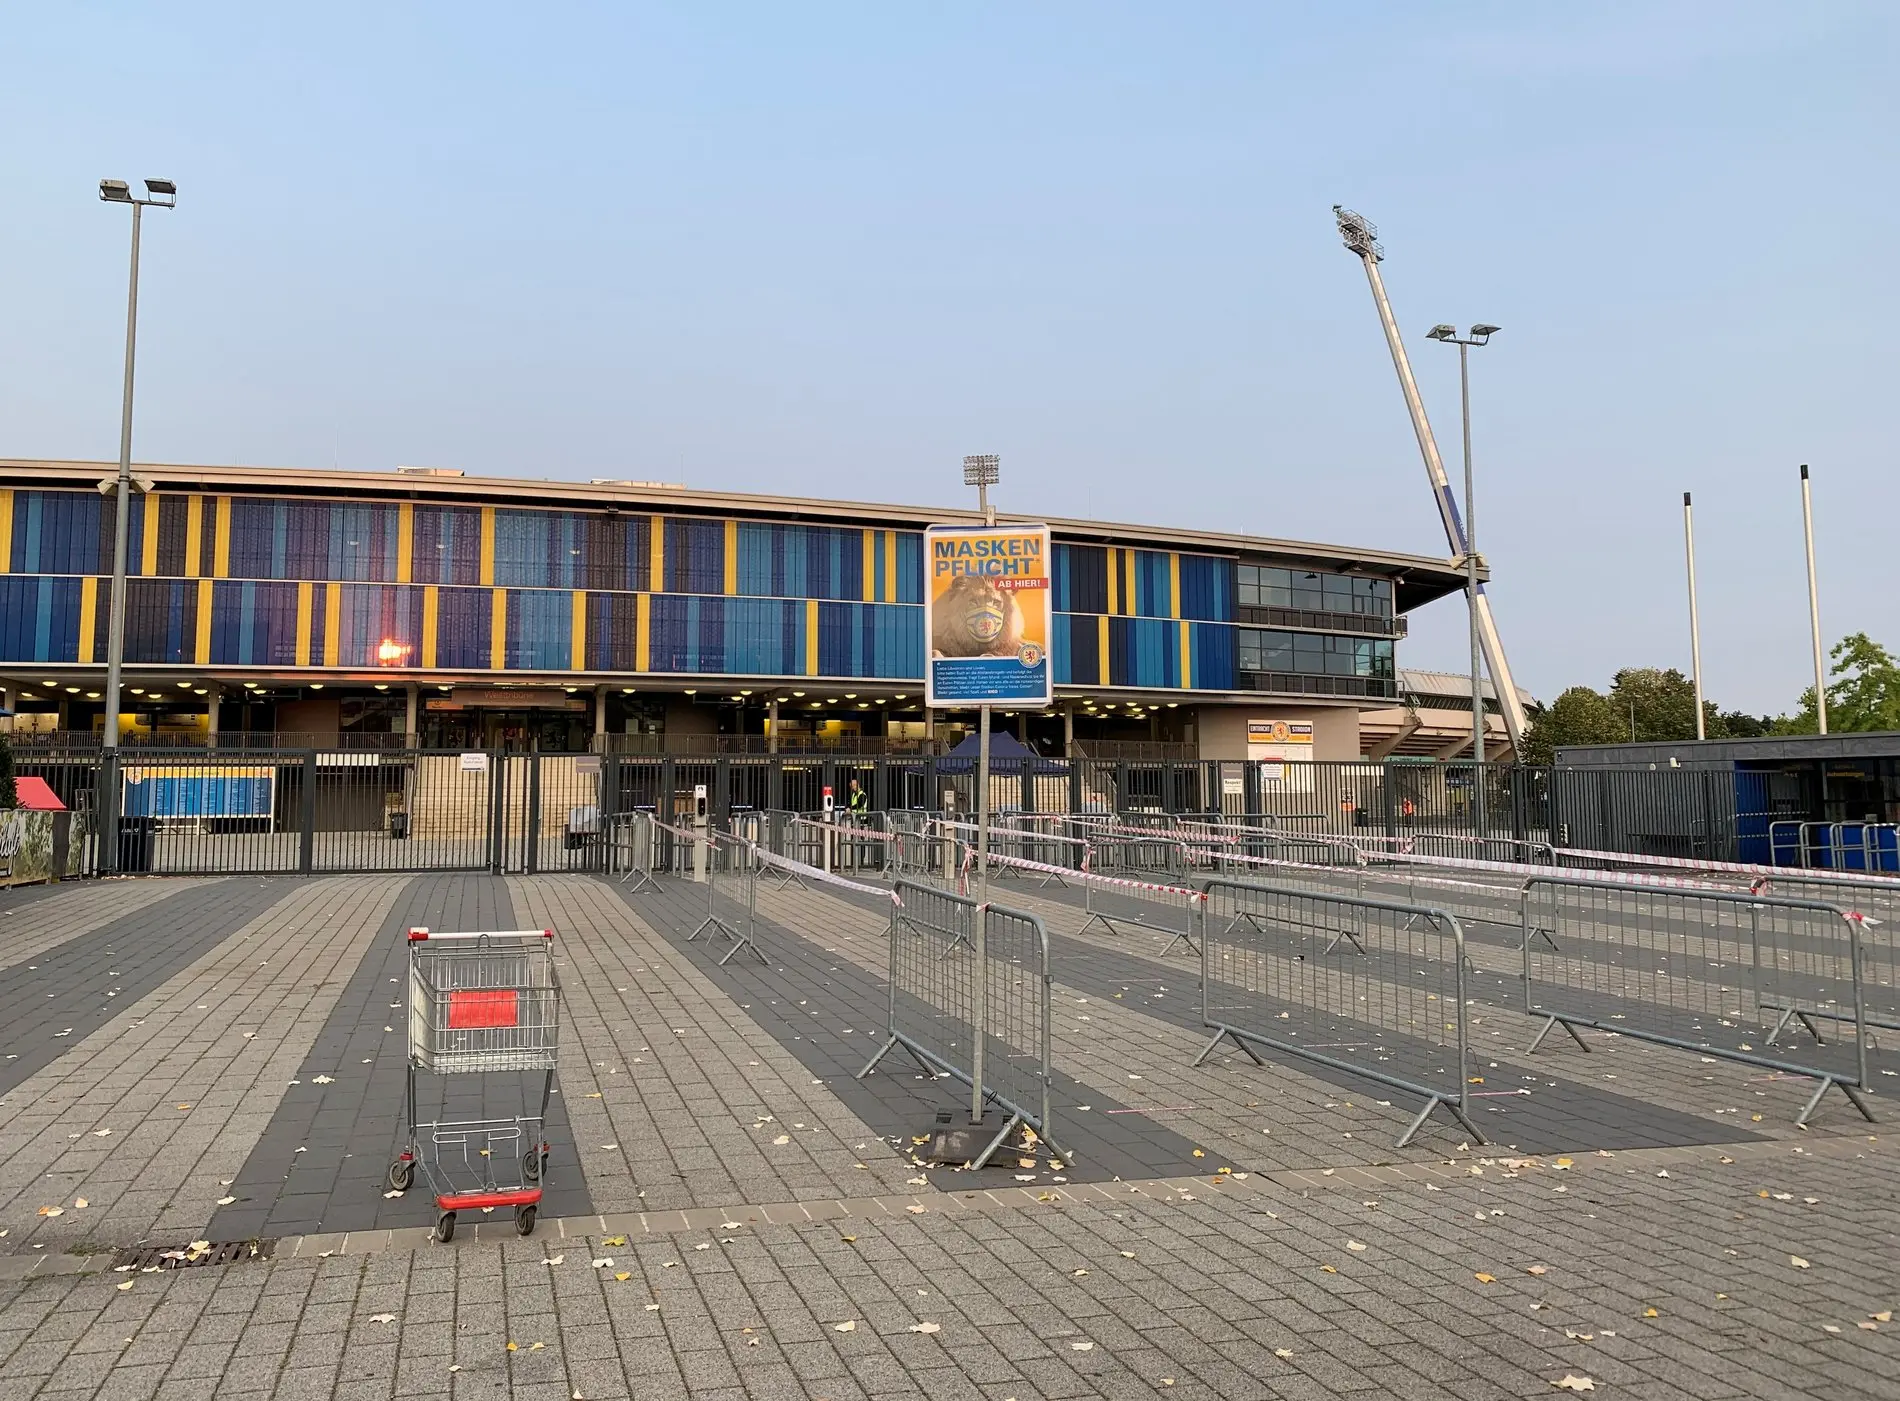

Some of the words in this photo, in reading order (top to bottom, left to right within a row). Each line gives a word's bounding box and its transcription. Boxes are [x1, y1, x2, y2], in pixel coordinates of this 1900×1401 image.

[935, 538, 1040, 558] MASKEN
[997, 580, 1012, 588] AB
[1014, 579, 1041, 588] HIER!
